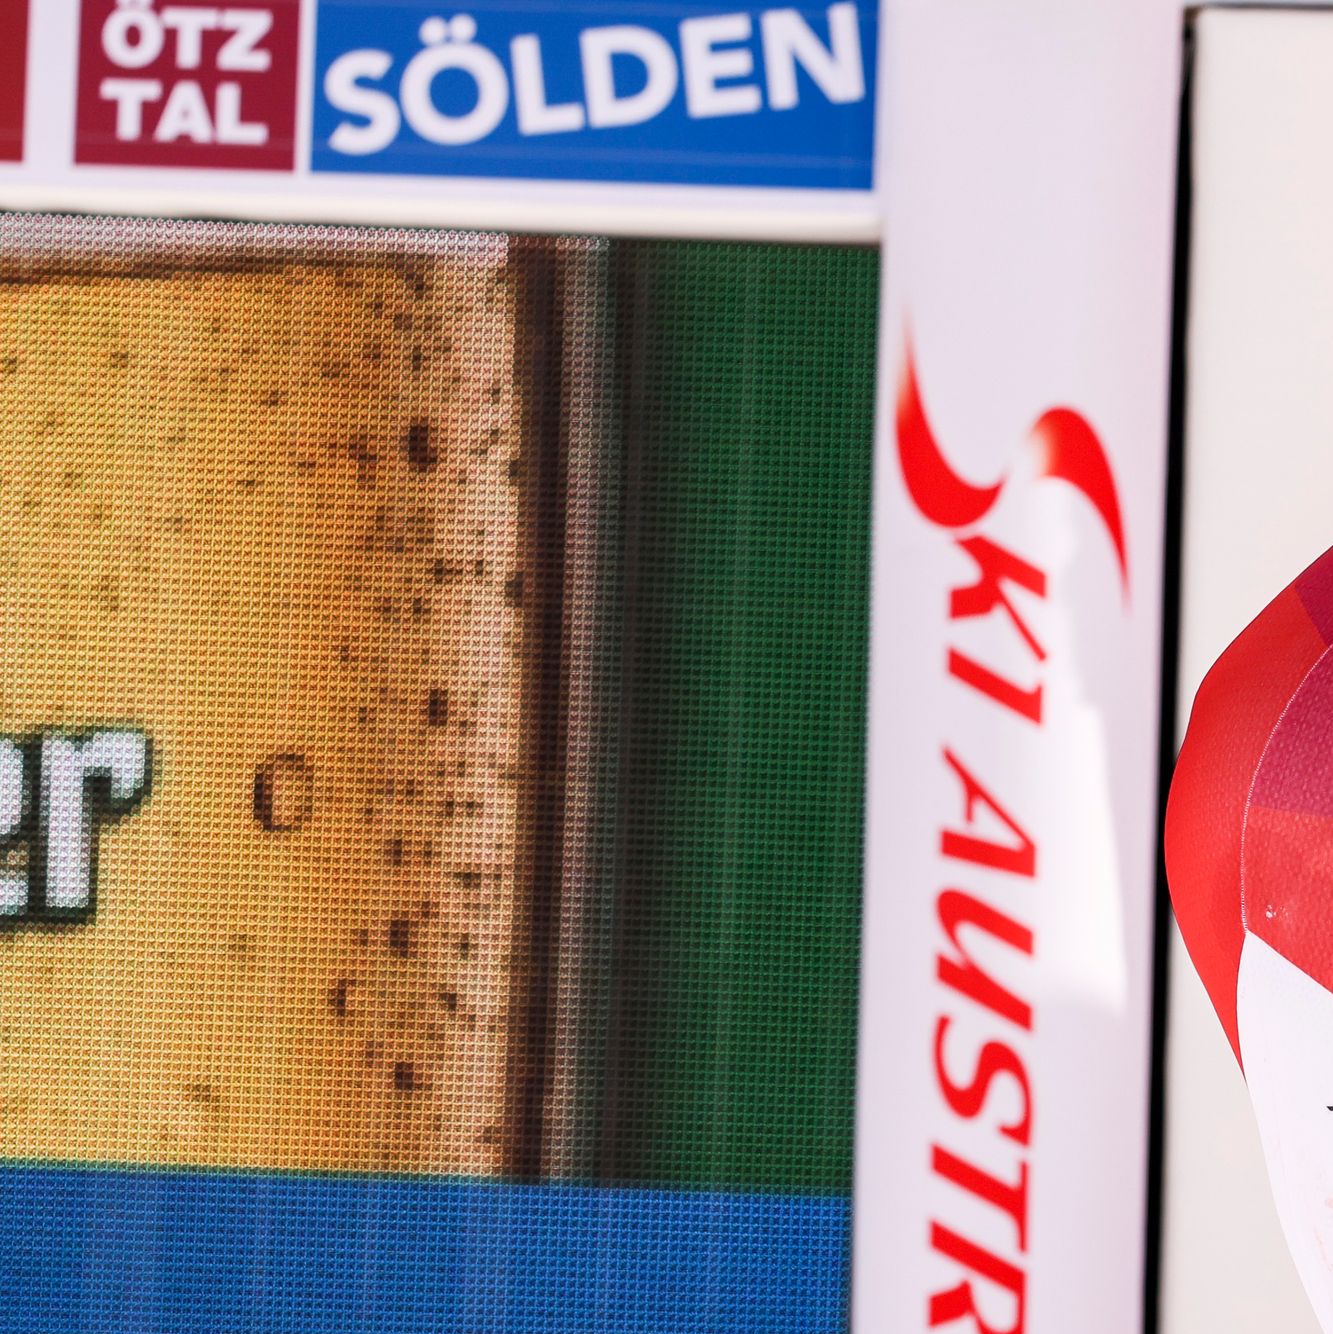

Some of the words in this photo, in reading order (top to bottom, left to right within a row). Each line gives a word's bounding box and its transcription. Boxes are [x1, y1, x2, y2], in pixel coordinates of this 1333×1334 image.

[101, 0, 272, 71] ÖTZ
[323, 3, 865, 155] SÖLDEN
[99, 79, 269, 145] TAL
[894, 335, 1131, 727] SKI
